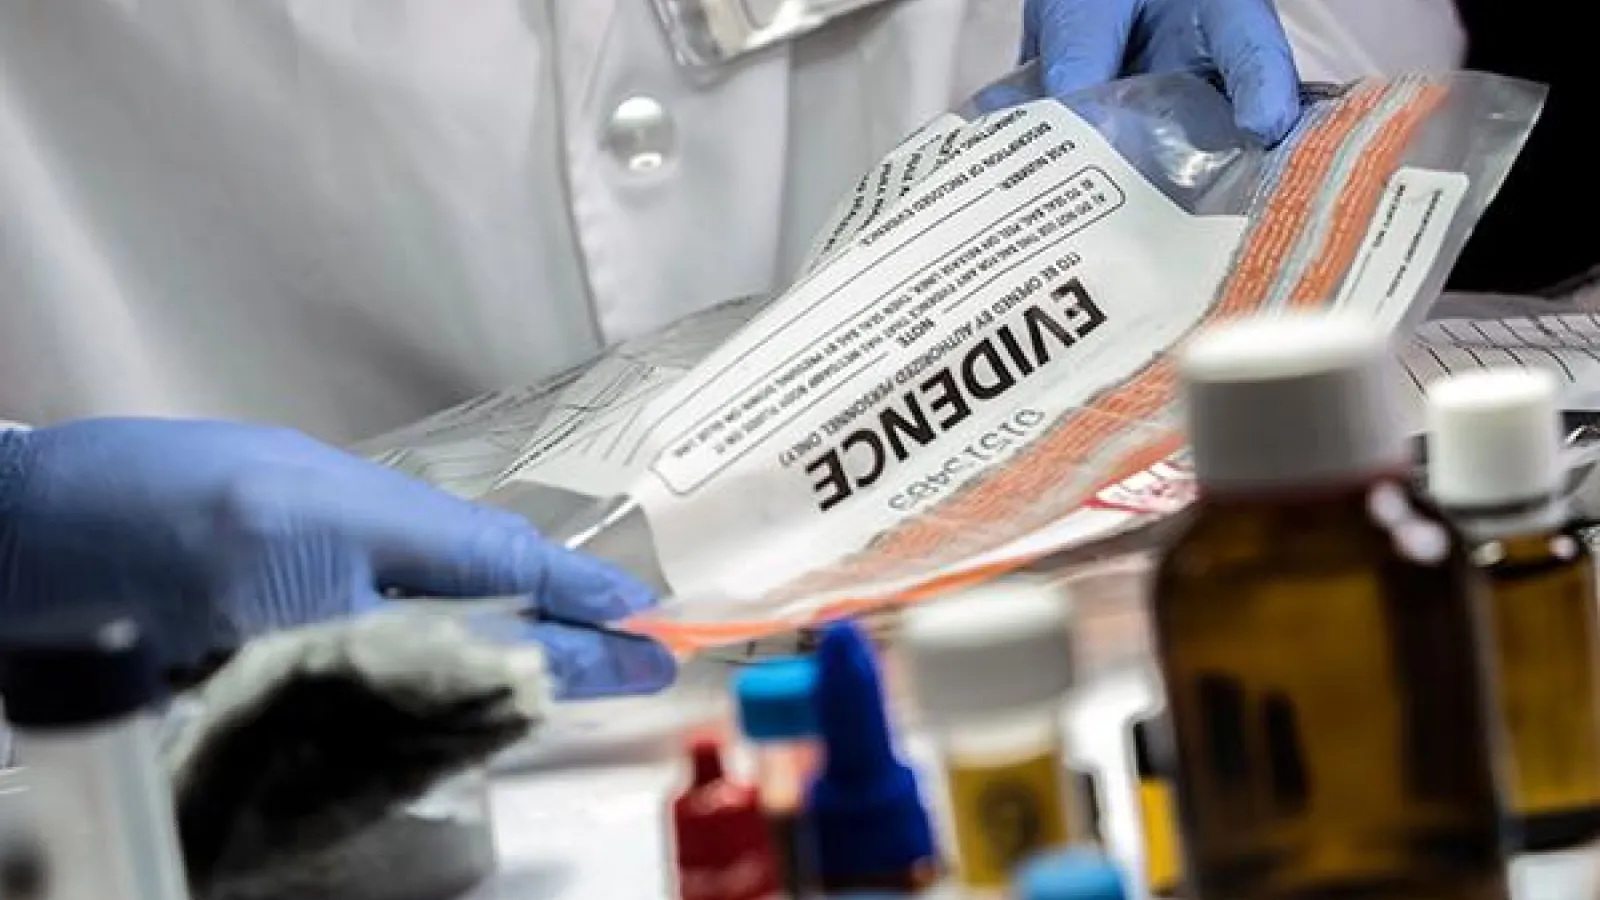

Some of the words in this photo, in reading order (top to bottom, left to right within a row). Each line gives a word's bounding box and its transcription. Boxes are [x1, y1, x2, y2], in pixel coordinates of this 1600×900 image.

[992, 272, 1043, 316] OPENED
[895, 316, 936, 348] NOTE
[975, 308, 995, 330] BY
[893, 321, 977, 386] AUTHORIZED
[805, 276, 1107, 511] EVIDENCE
[819, 377, 897, 436] PERSONNEL
[779, 431, 822, 468] ONLY)
